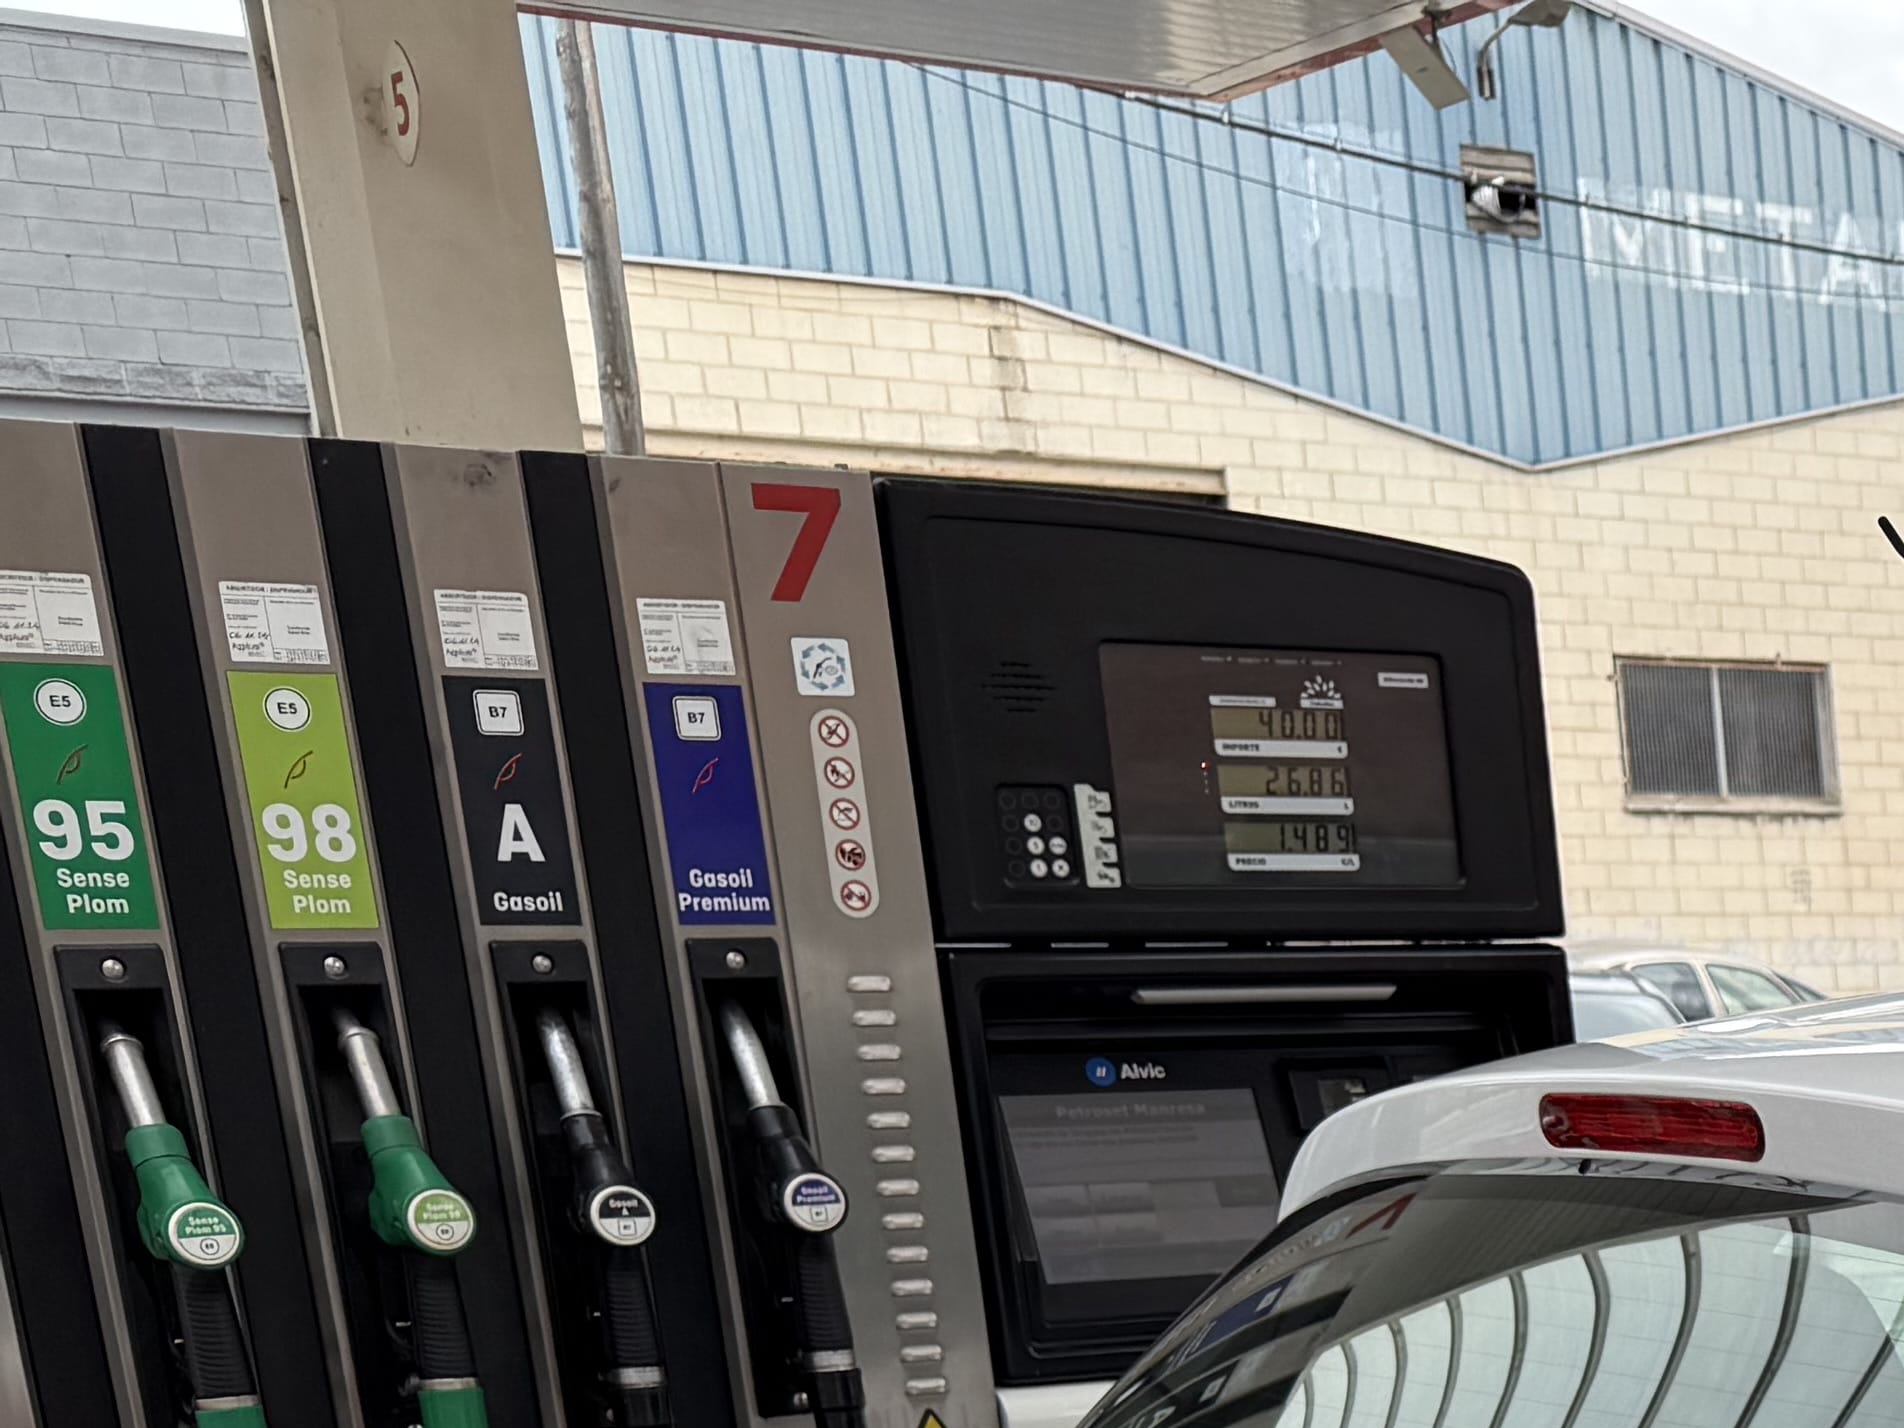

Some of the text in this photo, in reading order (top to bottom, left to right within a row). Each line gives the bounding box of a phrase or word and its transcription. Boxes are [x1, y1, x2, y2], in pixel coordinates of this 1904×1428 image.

[391, 70, 410, 136] 5
[751, 483, 842, 602] 7
[49, 695, 72, 708] E5
[277, 702, 298, 715] E5
[488, 706, 508, 718] B7
[687, 712, 706, 724] B7
[33, 799, 135, 861] 95
[262, 803, 357, 863] 98
[497, 803, 546, 862] A
[57, 868, 130, 888] Sense
[284, 869, 352, 889] Sense
[689, 868, 753, 888] Gasoil
[66, 894, 129, 914] Plom
[292, 895, 351, 914] Plom
[493, 891, 564, 912] Gasoil
[678, 893, 771, 912] Premium
[1120, 1063, 1166, 1080] Alvic
